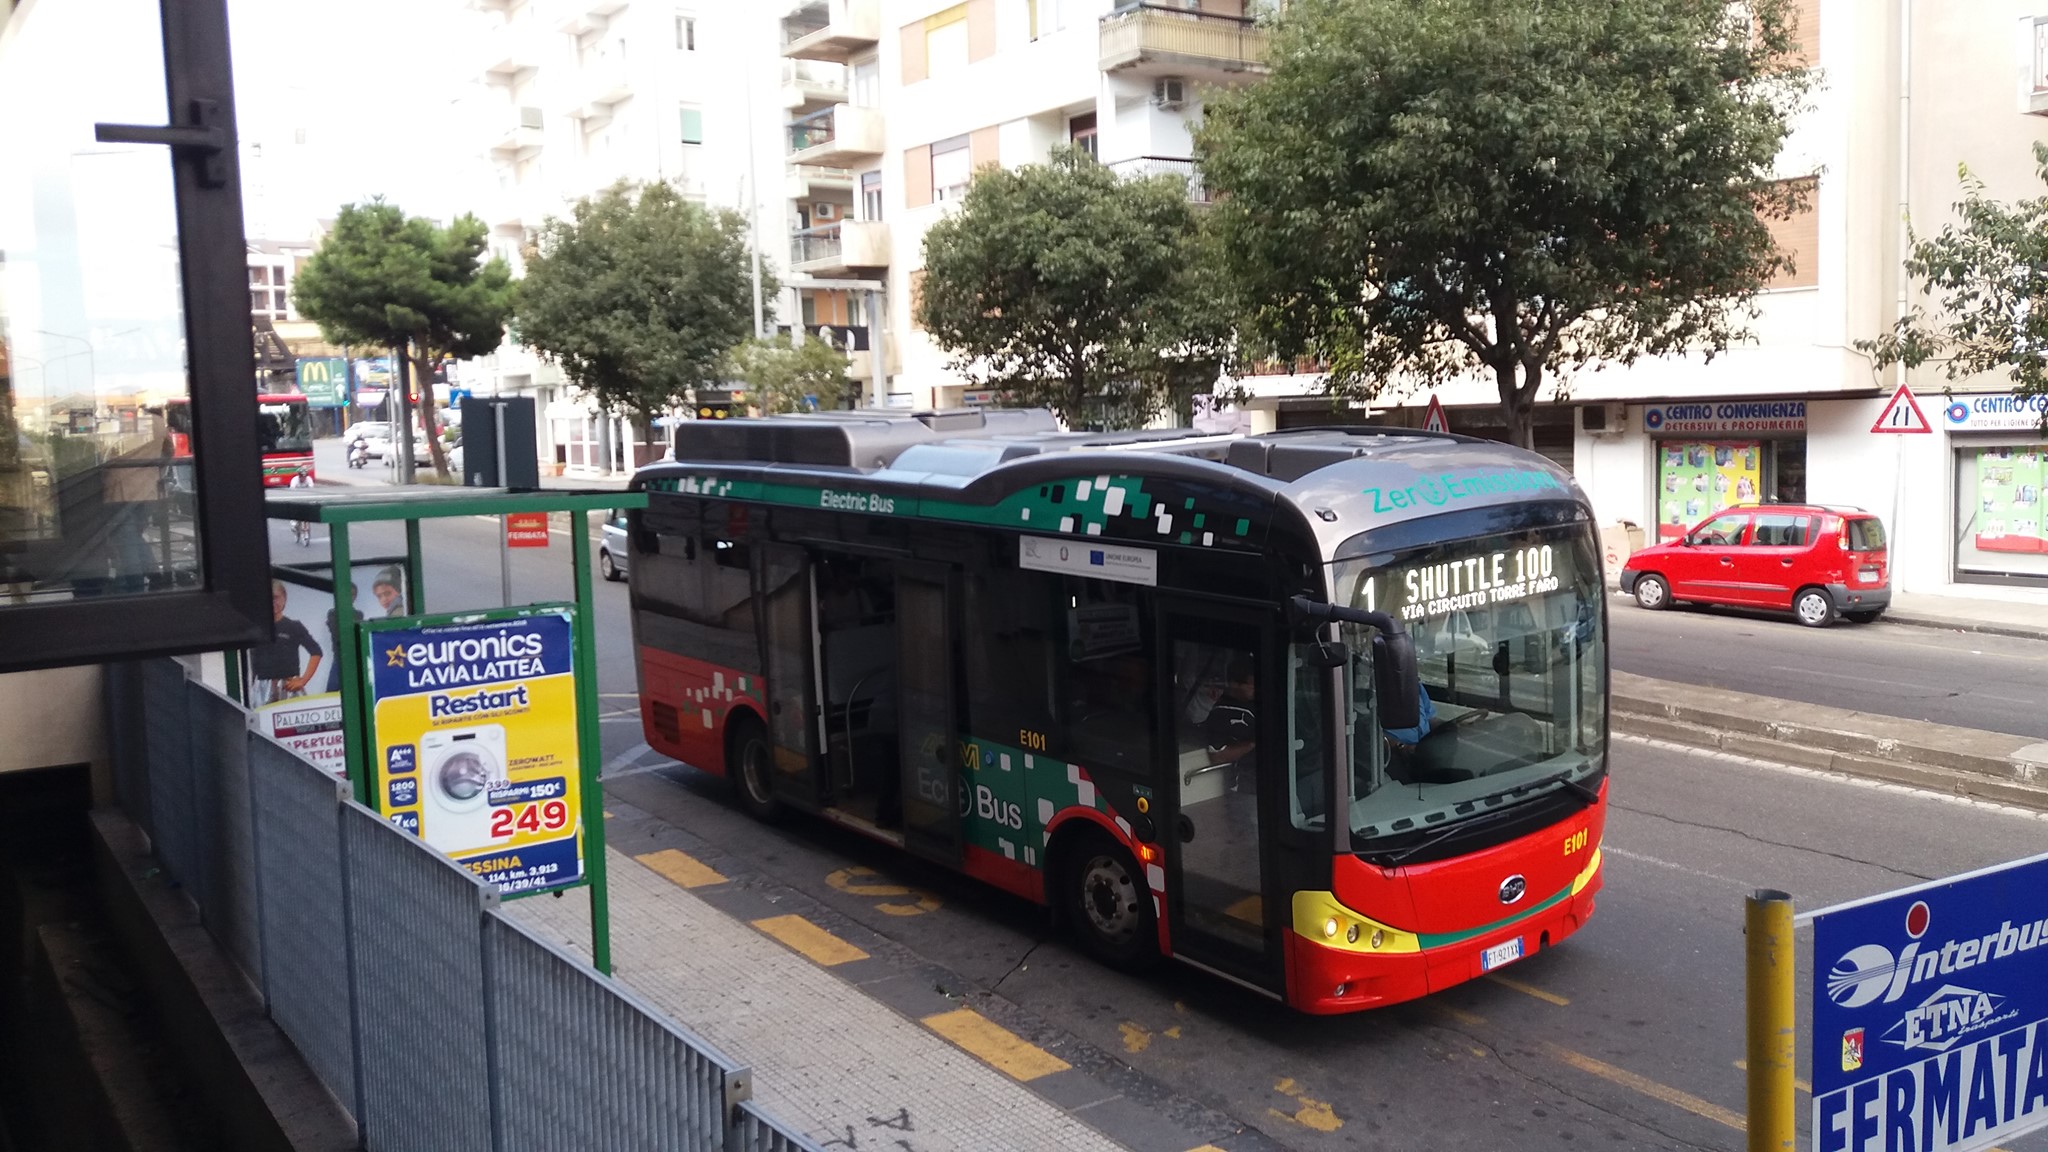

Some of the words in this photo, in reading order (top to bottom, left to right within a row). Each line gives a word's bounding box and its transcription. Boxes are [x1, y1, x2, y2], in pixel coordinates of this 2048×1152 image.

[1666, 405, 1712, 420] CENTRO
[1717, 402, 1805, 419] CONVENIENZA
[1974, 395, 2025, 413] CENTRO
[1665, 421, 1717, 431] DETERSIVI
[1721, 421, 1727, 430] E
[1732, 420, 1804, 431] PROFUMERIA
[1971, 419, 1988, 427] TUTTO
[1991, 419, 2001, 427] PER
[821, 489, 866, 511] Electric
[869, 493, 895, 514] Bus
[507, 531, 548, 540] FERMATA
[1406, 553, 1505, 603] SHUTTLE
[1516, 545, 1552, 583] 100
[1361, 576, 1375, 614] 1
[1401, 601, 1425, 620] VIA
[1428, 591, 1486, 616] CIRCUITO
[1489, 584, 1526, 603] TORRE
[1529, 576, 1559, 594] FARO
[406, 629, 543, 667] euronics
[472, 657, 546, 681] LATTEA
[431, 686, 528, 718] Restart
[276, 711, 321, 727] PALAZZO
[324, 709, 343, 721] DEL
[1020, 729, 1046, 751] E101
[509, 754, 554, 766] ZEROWATT
[391, 781, 415, 791] 1200
[491, 801, 567, 838] 249
[977, 784, 1022, 830] Bus
[1564, 828, 1588, 856] E101
[1904, 993, 1994, 1050] ETNA
[1820, 1020, 2048, 1152] FERMATA
